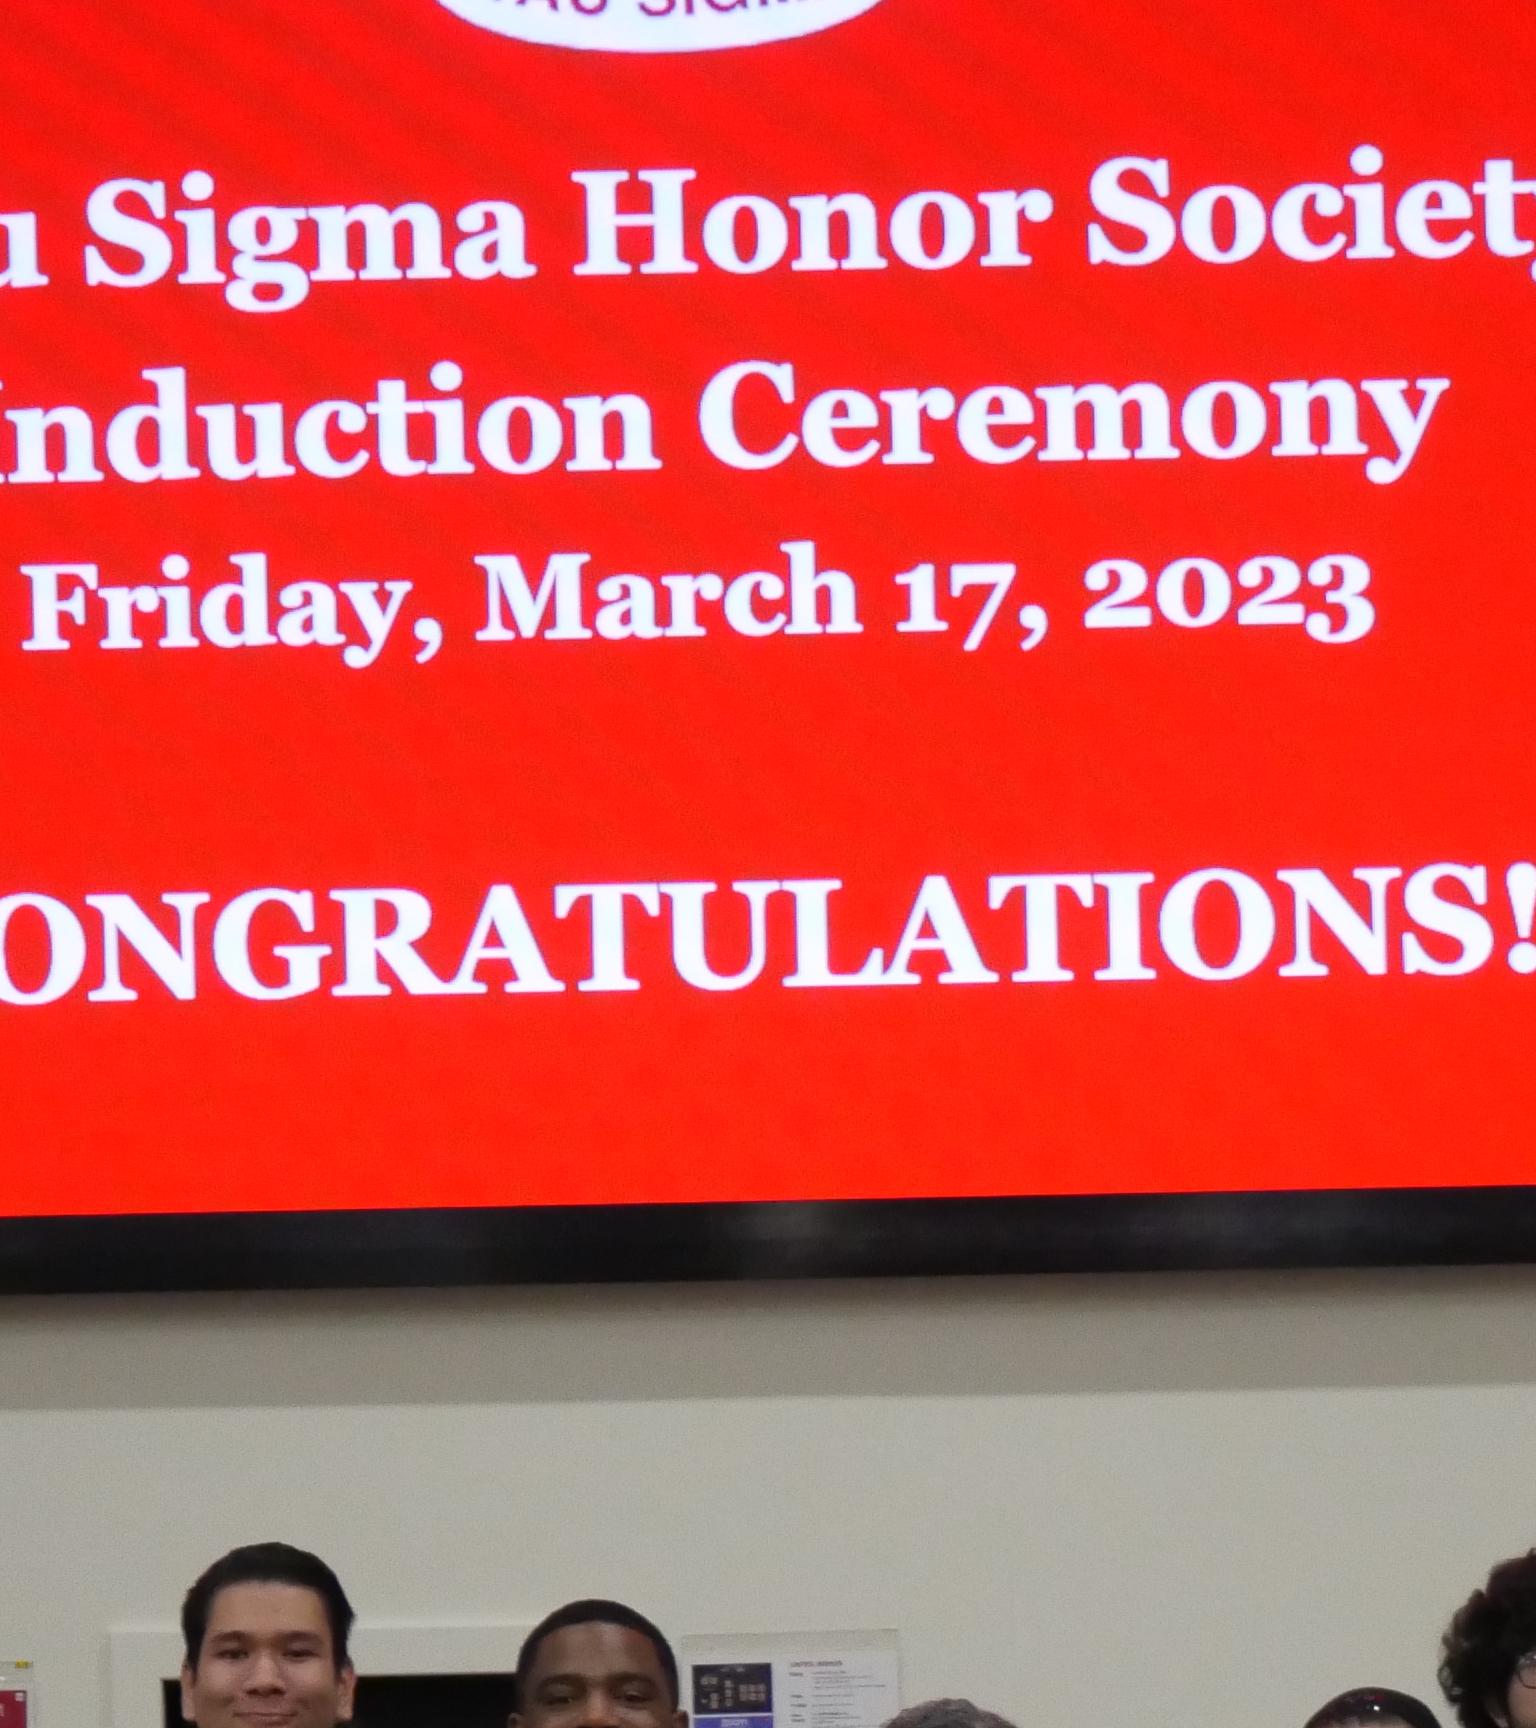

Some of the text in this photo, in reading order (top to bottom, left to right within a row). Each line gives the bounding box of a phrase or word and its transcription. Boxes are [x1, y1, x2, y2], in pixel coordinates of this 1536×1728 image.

[83, 170, 539, 314] Sigma
[570, 168, 1055, 277] Honor
[697, 358, 1452, 486] Ceremony
[18, 539, 1377, 670] Friday, March 17, 2023
